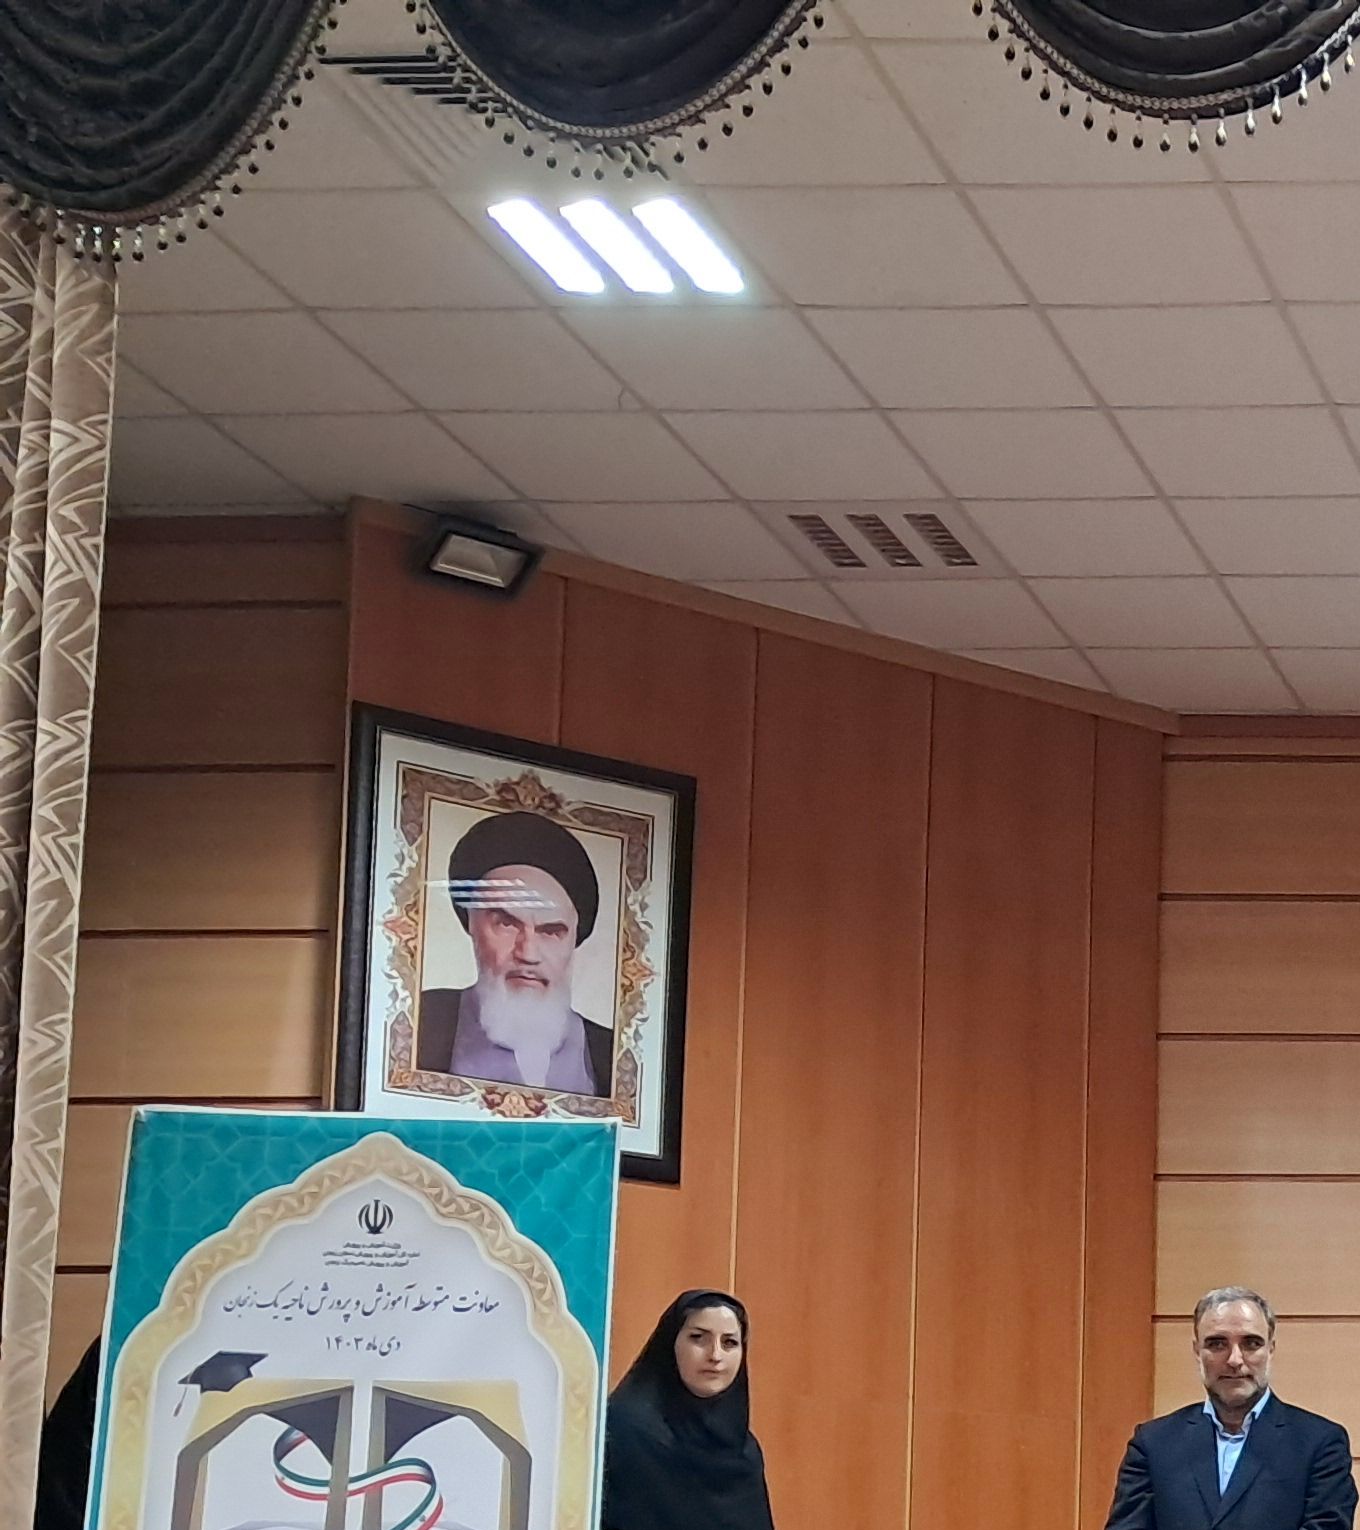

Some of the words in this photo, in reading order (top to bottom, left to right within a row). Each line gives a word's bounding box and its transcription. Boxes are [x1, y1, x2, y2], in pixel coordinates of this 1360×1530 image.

[307, 1281, 351, 1323] پرورش
[362, 1282, 417, 1316] آموزش
[379, 1336, 401, 1356] دی
